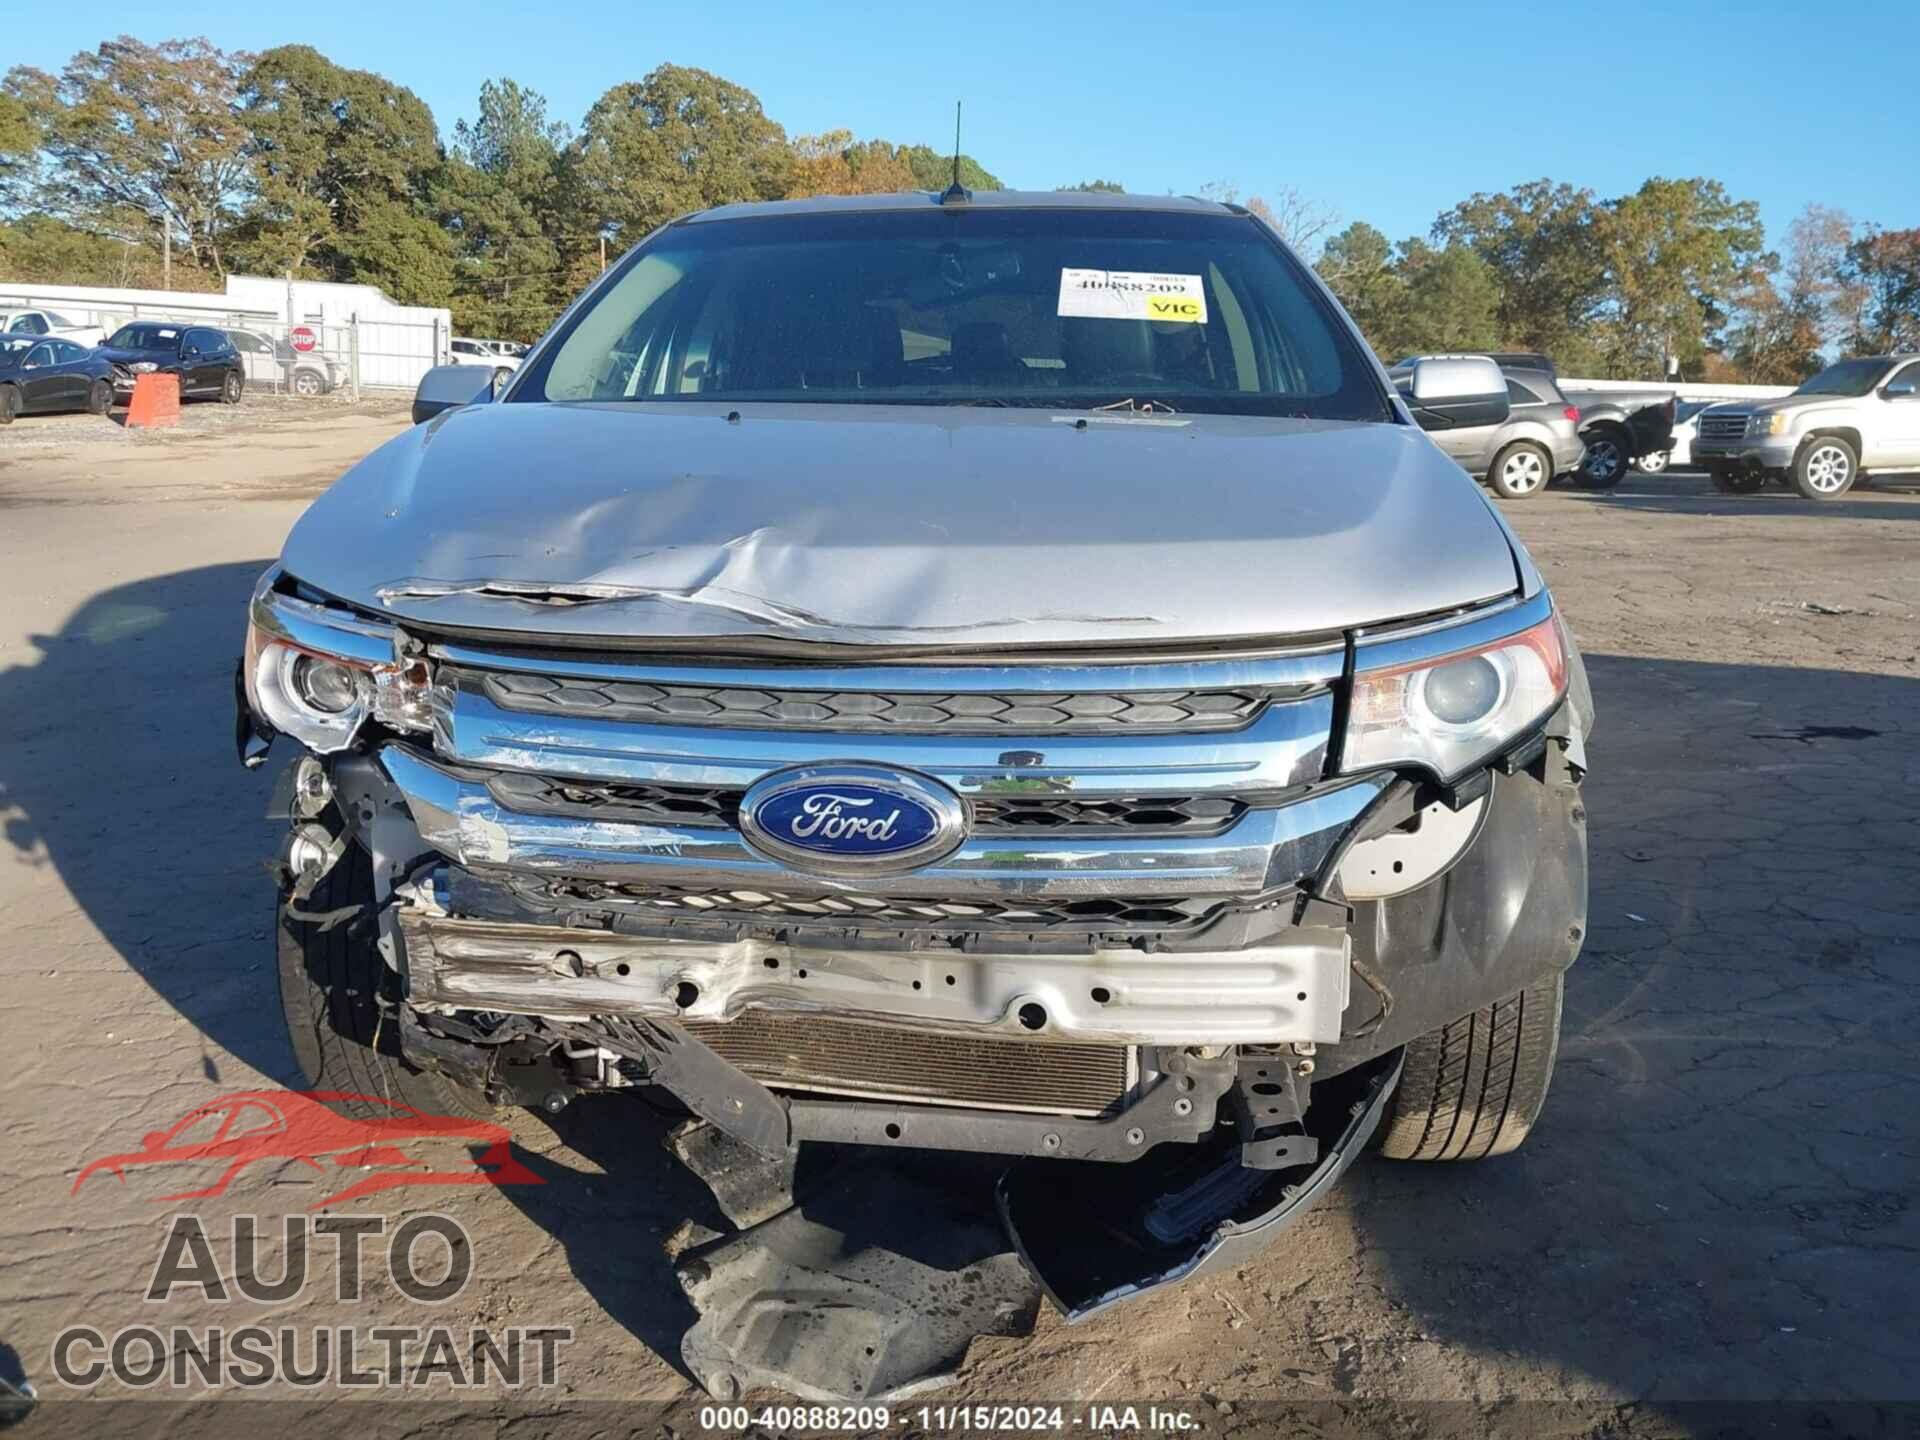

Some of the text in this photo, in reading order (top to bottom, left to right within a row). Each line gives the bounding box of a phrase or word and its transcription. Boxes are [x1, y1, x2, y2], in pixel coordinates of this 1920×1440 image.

[1153, 303, 1198, 315] VIC
[290, 334, 316, 346] STOP
[791, 793, 900, 842] Ford
